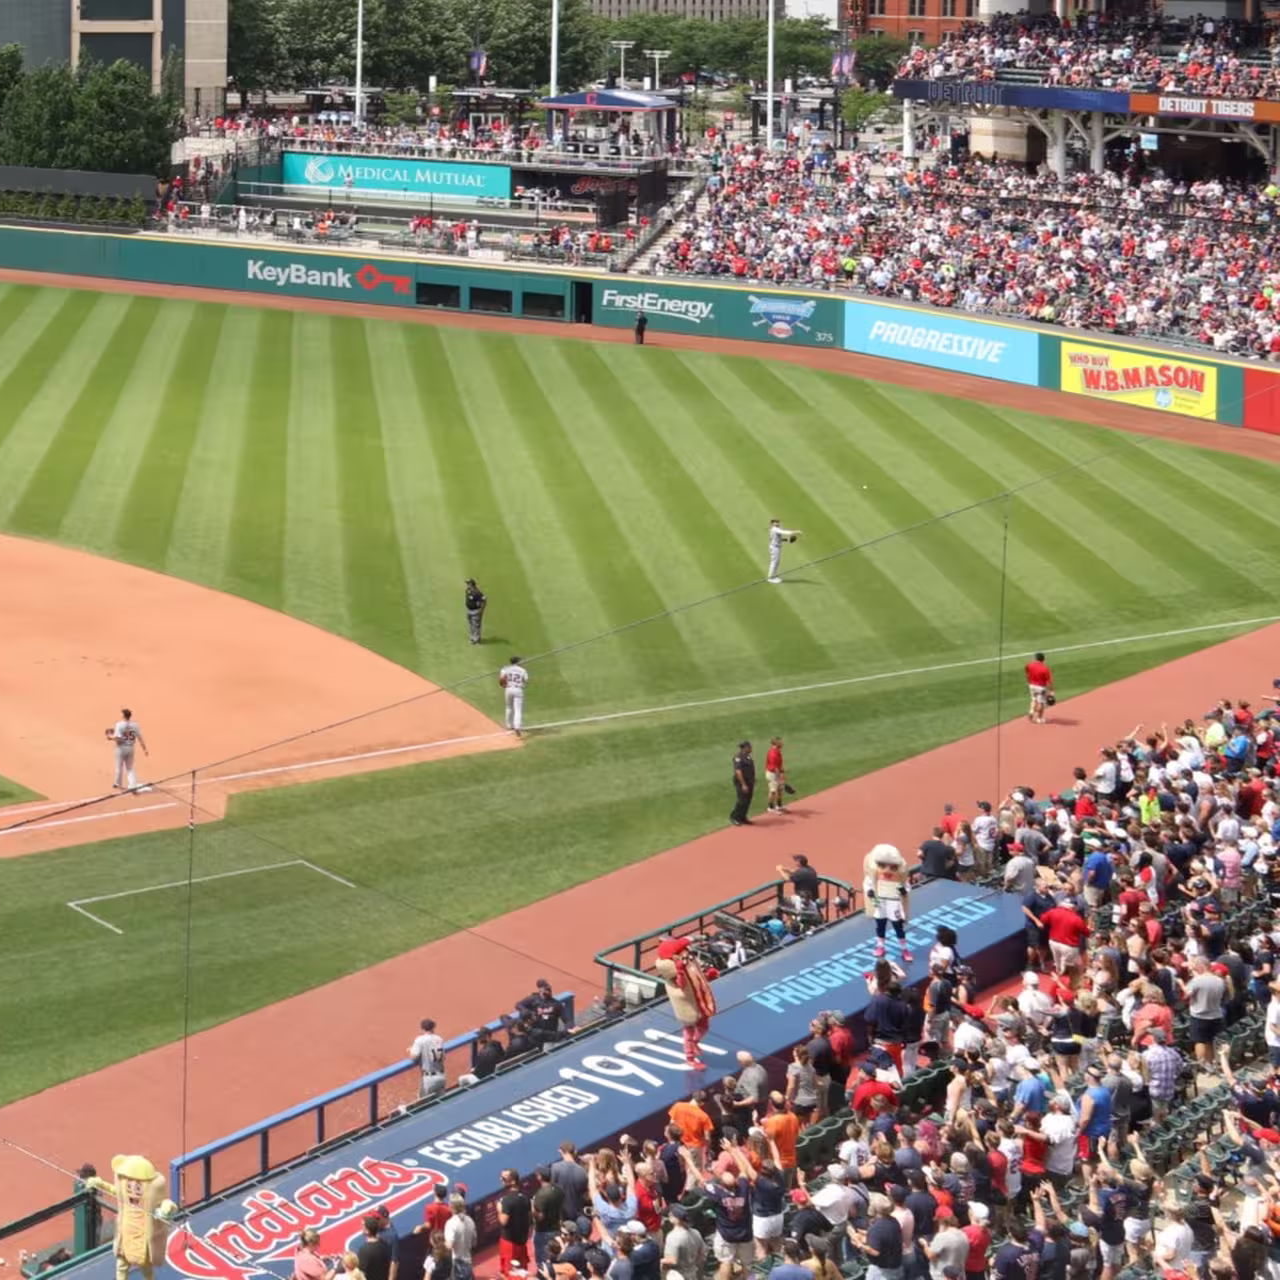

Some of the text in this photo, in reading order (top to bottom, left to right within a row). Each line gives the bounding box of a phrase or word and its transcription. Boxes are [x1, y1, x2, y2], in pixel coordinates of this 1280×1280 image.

[1158, 96, 1255, 117] DETROIT TIGERS
[338, 163, 485, 187] MEDICAL MUTUAL
[246, 259, 353, 290] KeyBank
[602, 289, 713, 320] FirstEnergy
[814, 332, 834, 343] 375
[869, 320, 1006, 364] PROGRESSIVE
[1068, 354, 1111, 368] WHO BUY
[1082, 365, 1206, 393] W.B.MASON
[418, 1027, 728, 1169] ESTABLISHED 1901
[166, 1155, 450, 1280] Indians
